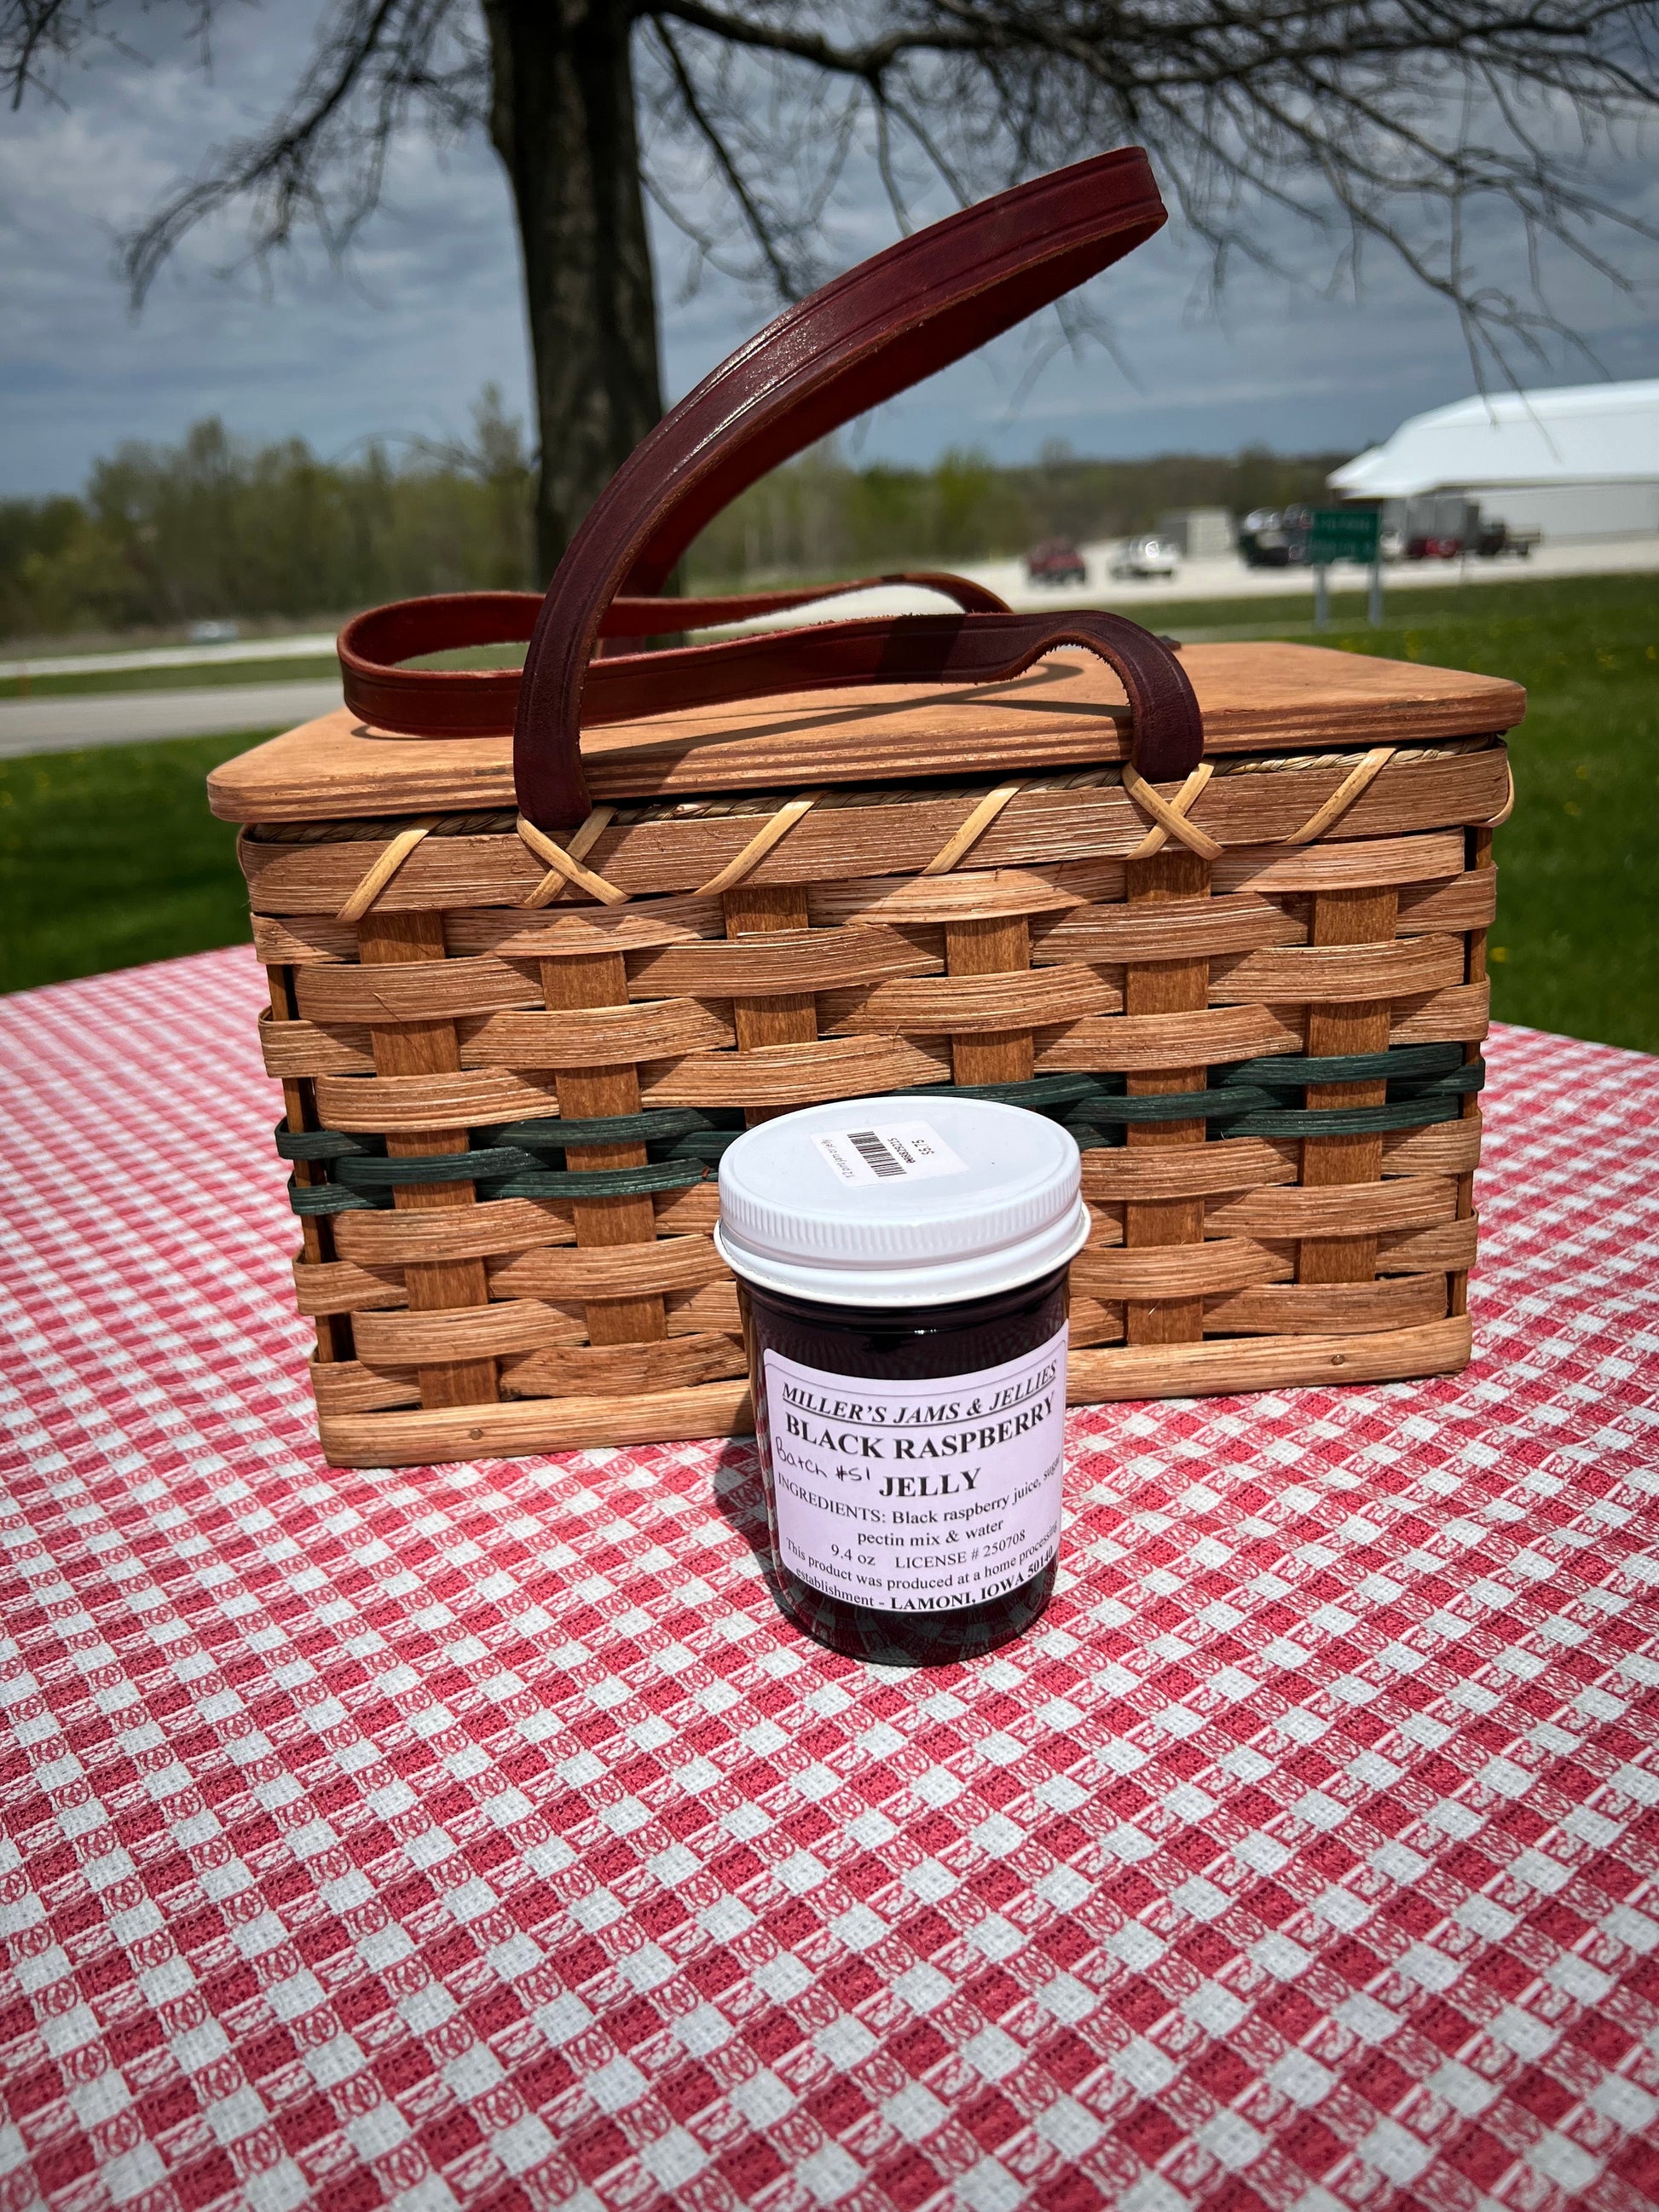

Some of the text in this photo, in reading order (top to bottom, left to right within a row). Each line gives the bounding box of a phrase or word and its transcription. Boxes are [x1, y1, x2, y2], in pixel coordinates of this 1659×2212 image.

[783, 1360, 1056, 1424] MILLER'S JAMS & JELLIES
[785, 1390, 1055, 1459] BLACK RASPBERRY
[776, 1436, 828, 1478] Batch
[879, 1467, 981, 1498] JELLY
[778, 1472, 886, 1524] INGREDIENTS:
[893, 1510, 938, 1524] Black
[944, 1495, 1009, 1521] raspberry
[1012, 1478, 1041, 1505] juice,
[786, 1521, 1058, 1591] This product was produced at a home processing
[831, 1528, 1026, 1568] 9.4 oz LICENSE # 250708
[858, 1520, 1004, 1547] pectin mix & water
[796, 1567, 875, 1607] establishment
[890, 1591, 976, 1610] LAMONI,
[981, 1572, 1025, 1600] IOWA
[1027, 1545, 1053, 1577] 50140
